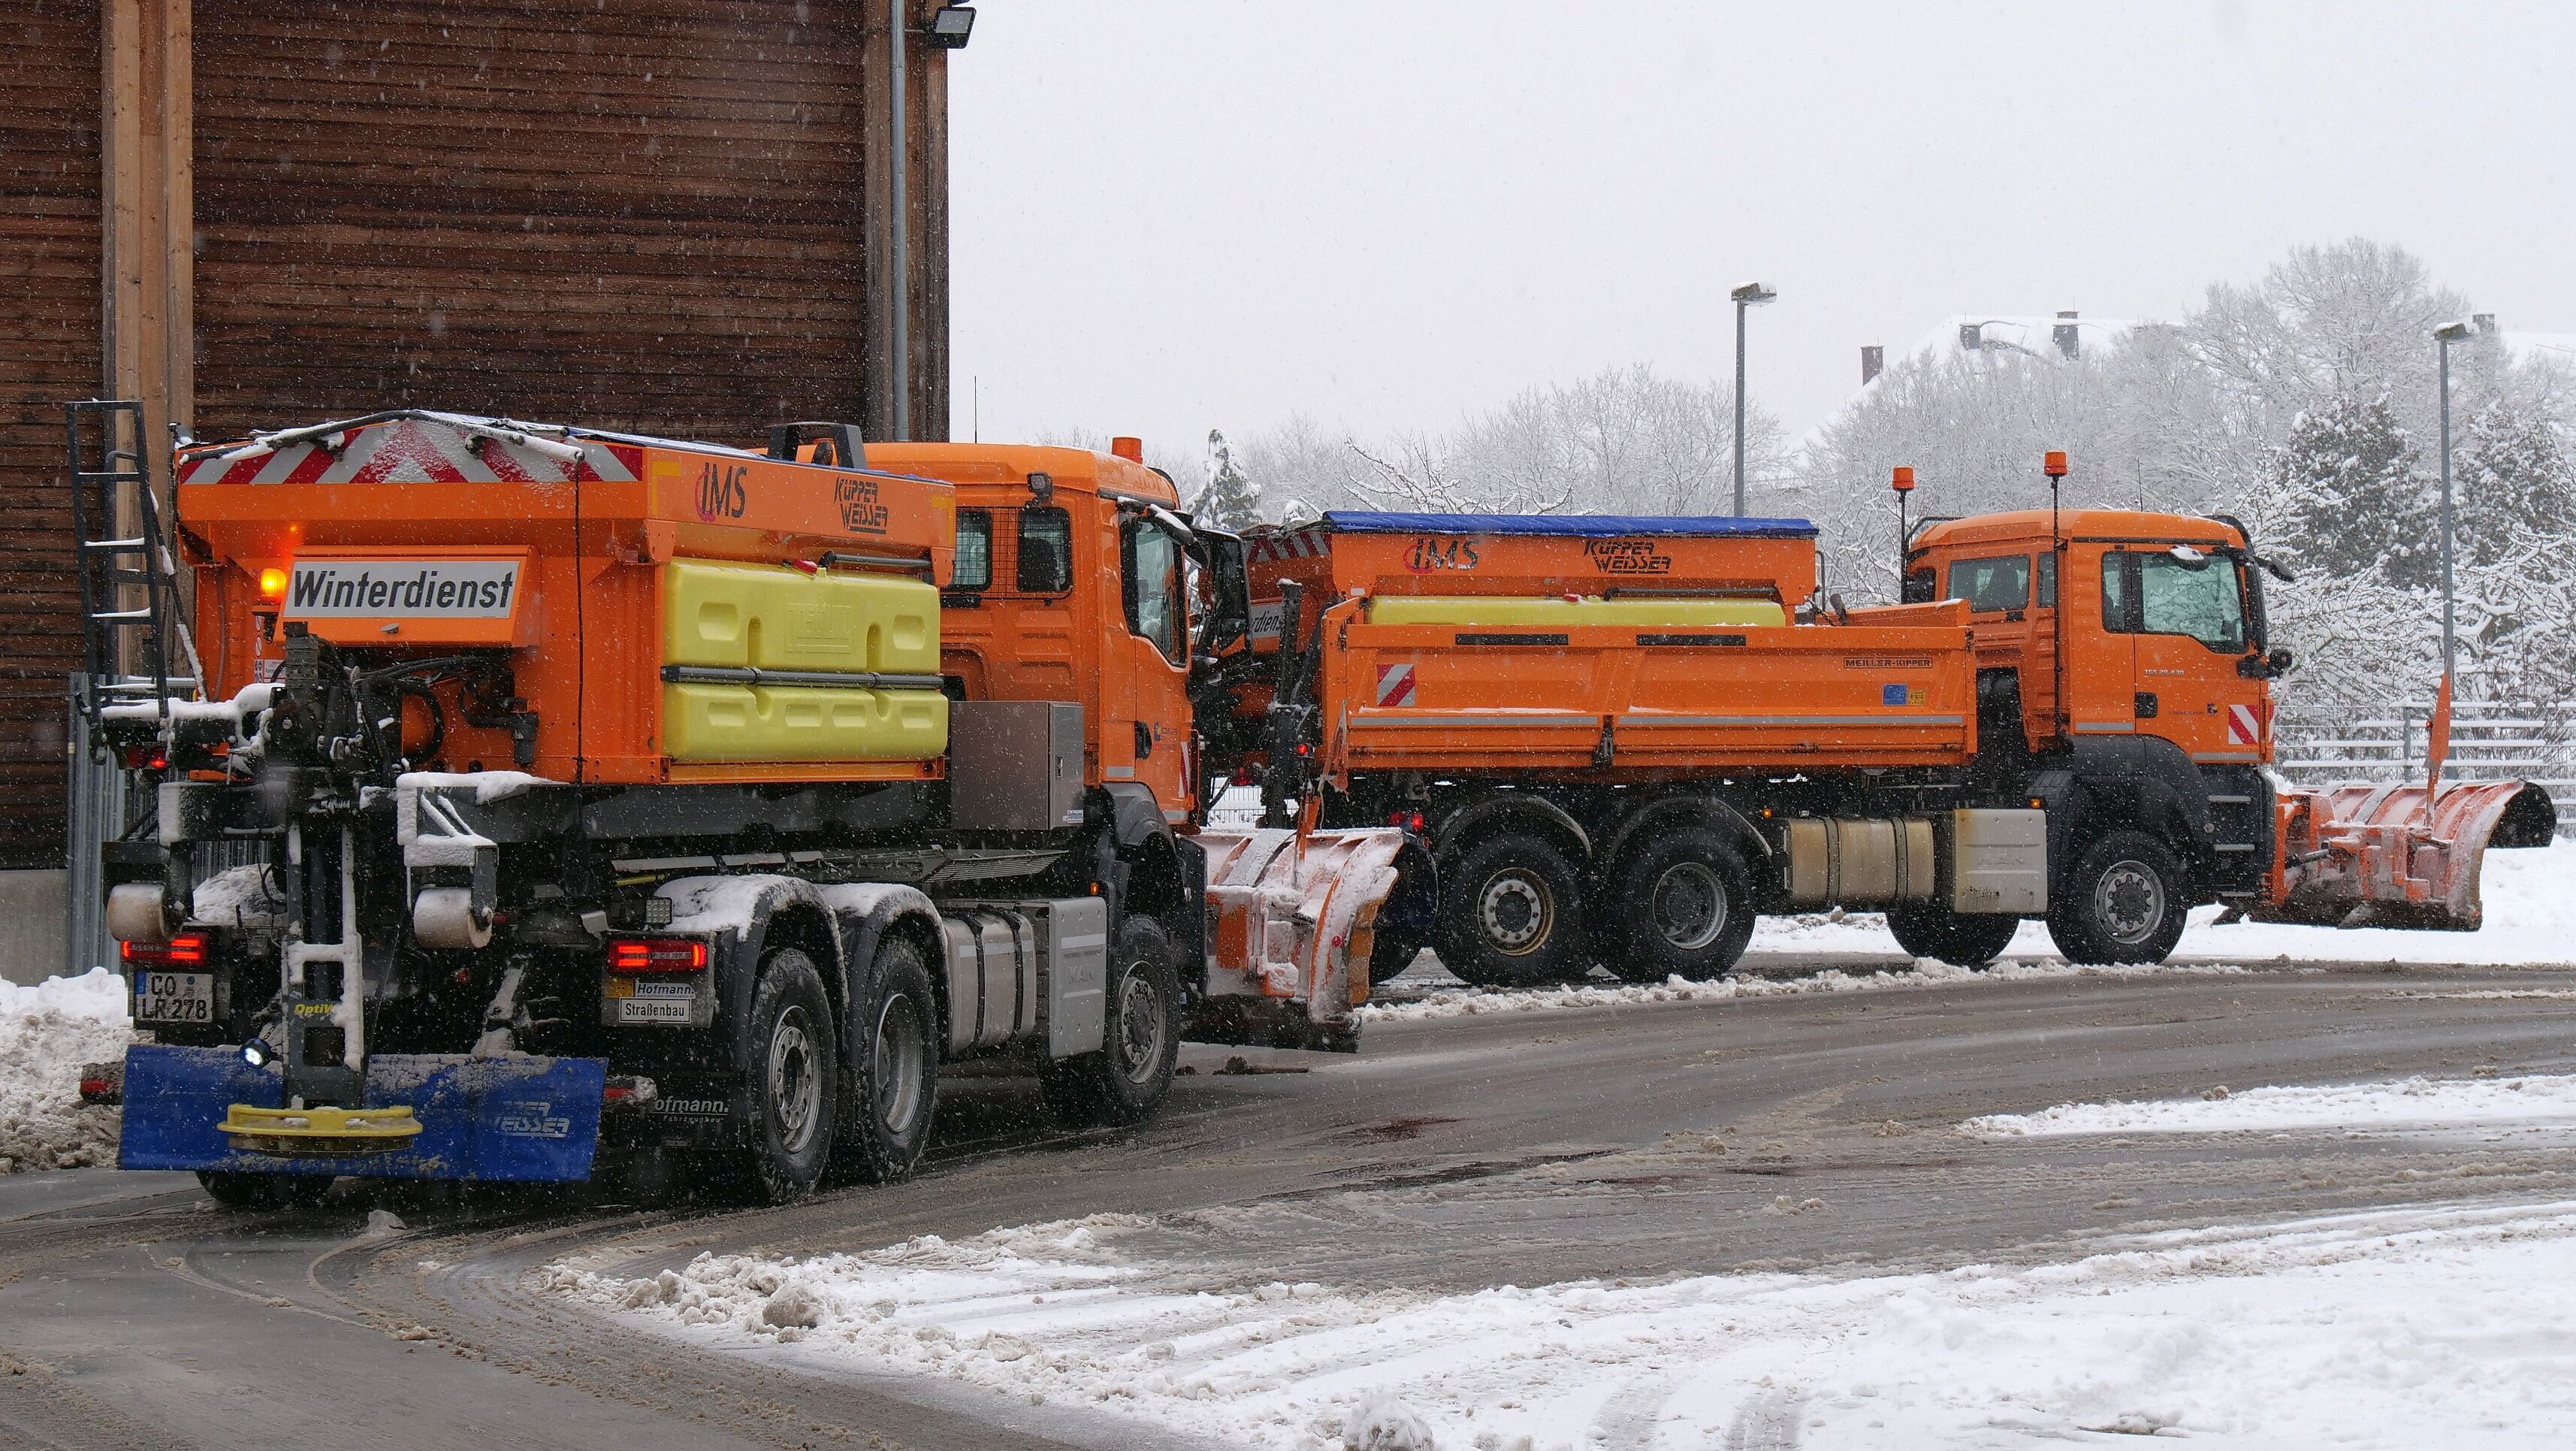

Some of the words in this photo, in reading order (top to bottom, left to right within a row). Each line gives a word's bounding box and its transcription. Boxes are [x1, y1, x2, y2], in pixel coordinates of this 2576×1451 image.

[696, 461, 747, 521] IMS
[1403, 538, 1478, 573] IMS
[294, 570, 512, 608] Winterdienst
[151, 975, 177, 996] CO
[142, 998, 166, 1019] LR
[171, 999, 207, 1020] 278
[625, 1003, 684, 1017] Straßenbau
[654, 1096, 729, 1112] ofmann.
